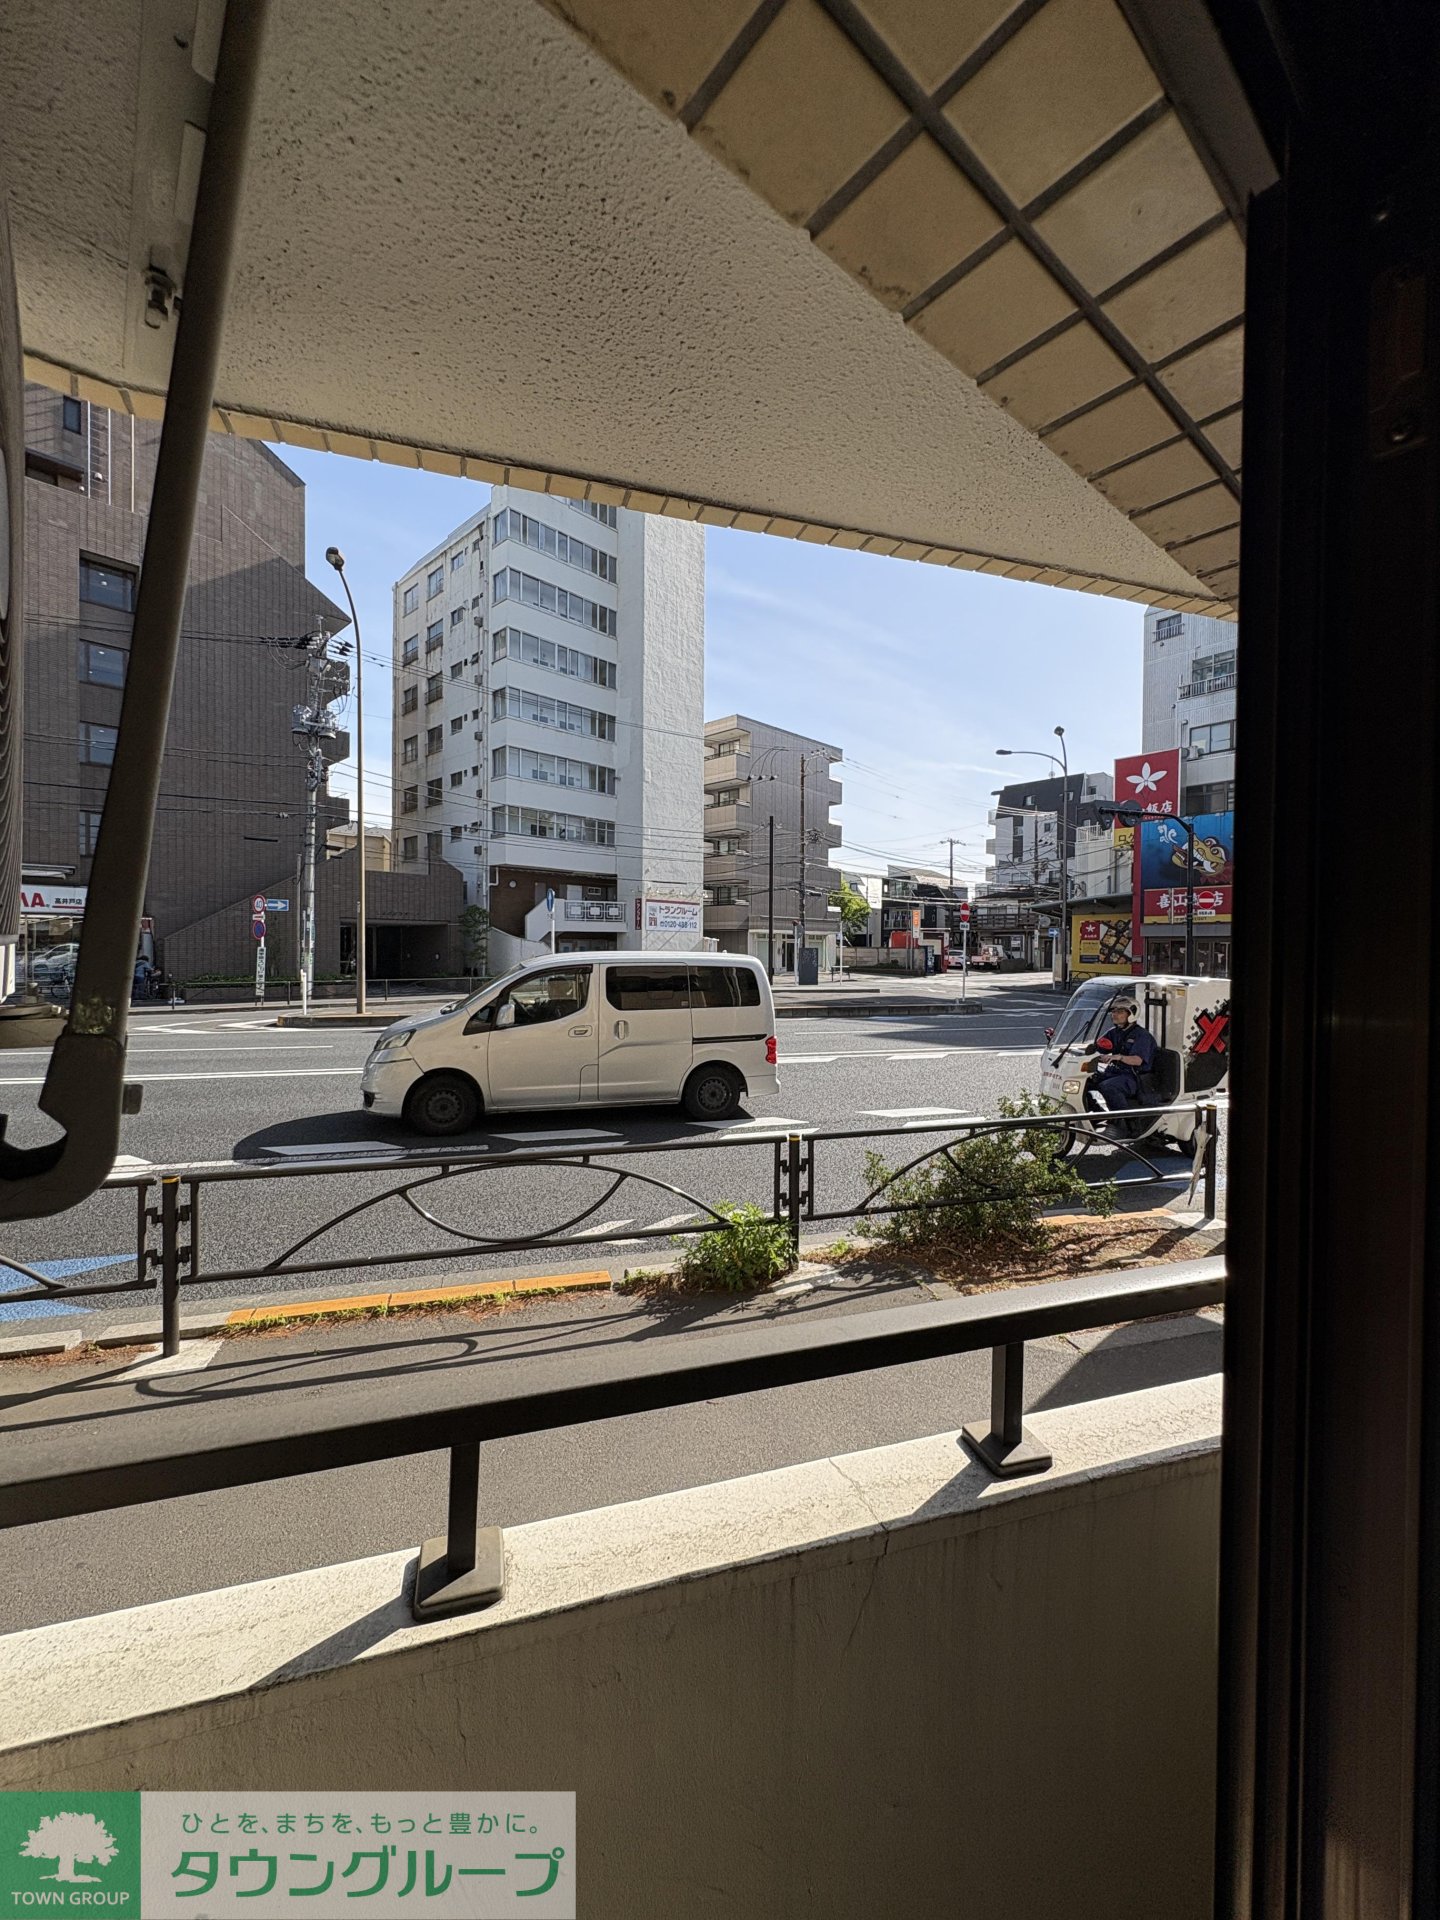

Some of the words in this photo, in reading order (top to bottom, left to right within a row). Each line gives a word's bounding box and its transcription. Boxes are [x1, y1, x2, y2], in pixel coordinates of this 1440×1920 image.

[658, 905, 698, 916] トランクルーム
